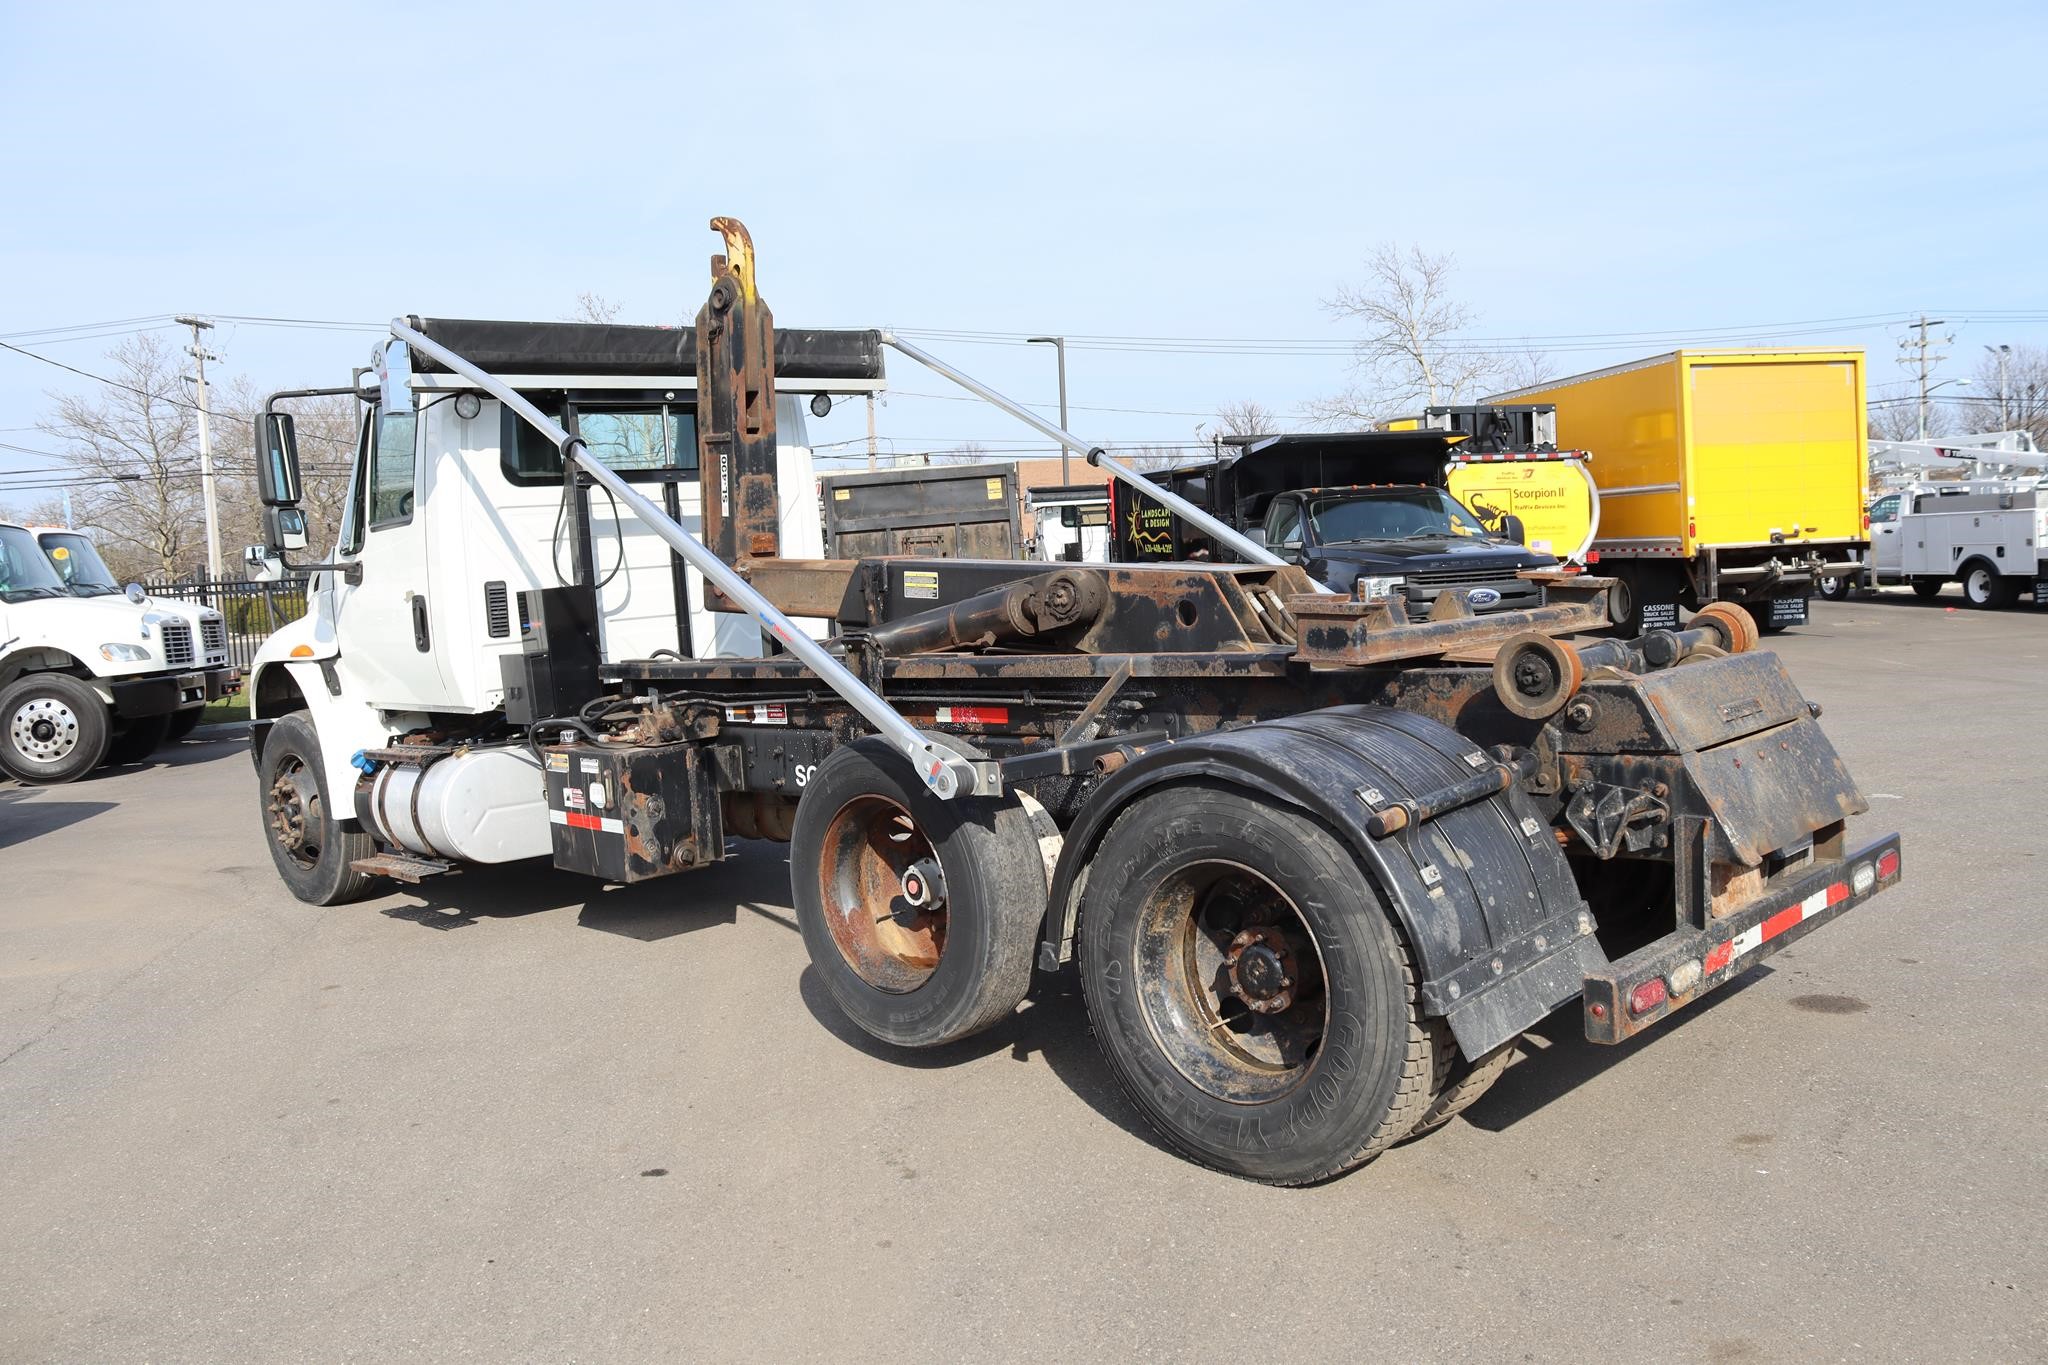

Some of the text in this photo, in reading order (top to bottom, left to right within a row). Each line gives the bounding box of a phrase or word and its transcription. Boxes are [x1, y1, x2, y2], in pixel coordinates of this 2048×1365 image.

[1513, 487, 1564, 500] Scorpion II
[1150, 518, 1170, 528] DESIGN
[1472, 593, 1492, 603] Ford
[1643, 603, 1675, 612] CASSONE
